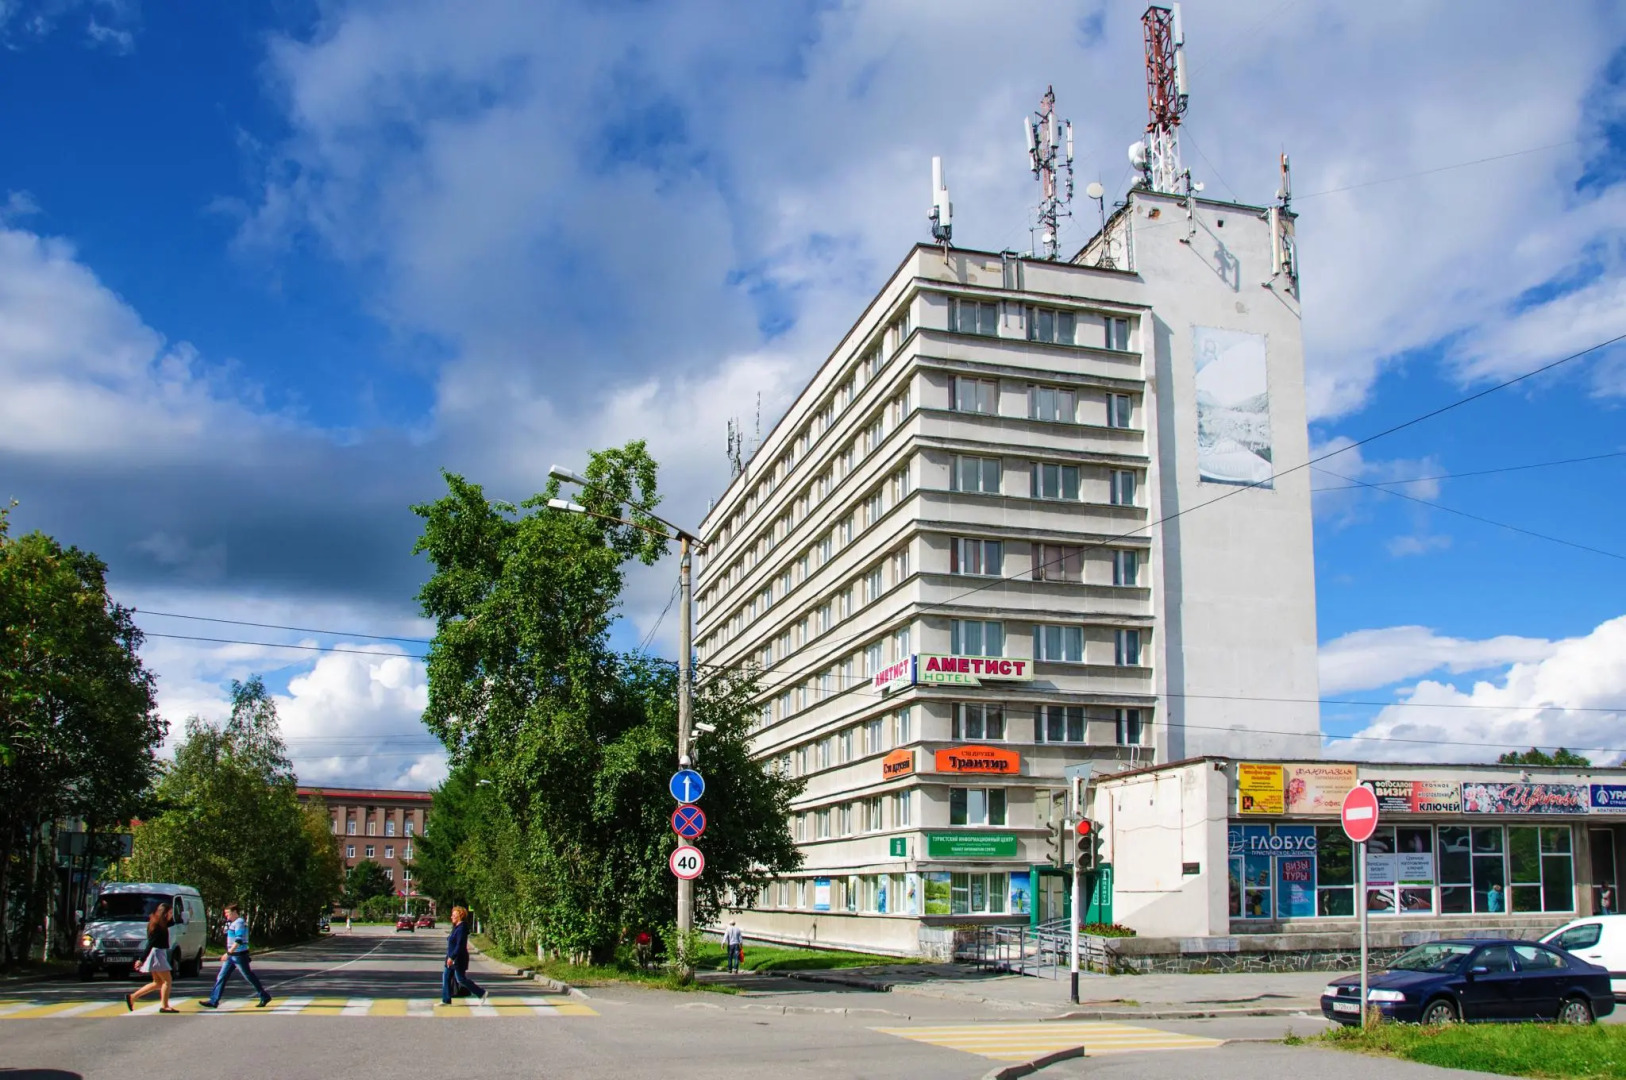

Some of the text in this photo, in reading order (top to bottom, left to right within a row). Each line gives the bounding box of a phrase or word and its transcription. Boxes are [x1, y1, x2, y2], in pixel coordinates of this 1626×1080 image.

[926, 657, 1026, 676] АМЕТИСТ
[875, 659, 909, 688] АМЕТИСТ
[924, 673, 971, 683] HOTEL
[1376, 788, 1414, 797] ВИЗИТ
[1419, 801, 1460, 812] КЛЮЧЕЙ
[1250, 835, 1317, 850] ГЛОБУС
[678, 856, 697, 870] 40
[1285, 861, 1308, 871] ВИЗЫ
[1285, 872, 1308, 881] ТУРЫ
